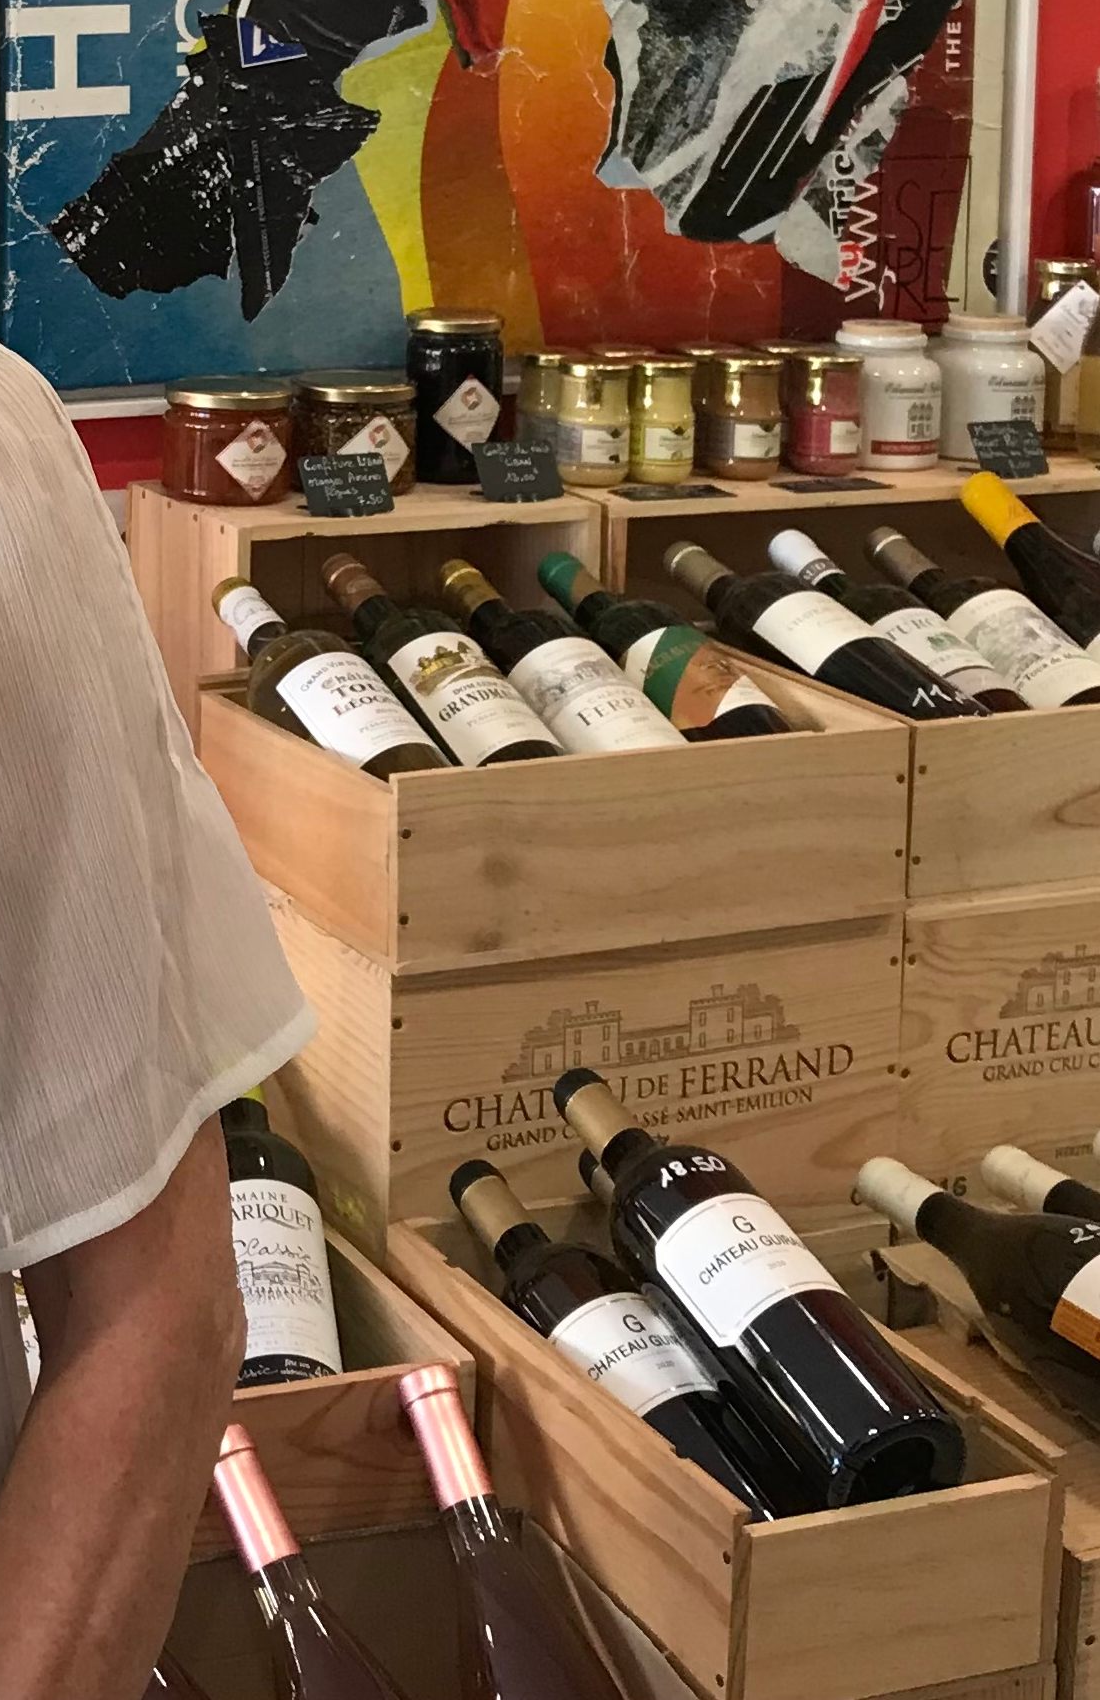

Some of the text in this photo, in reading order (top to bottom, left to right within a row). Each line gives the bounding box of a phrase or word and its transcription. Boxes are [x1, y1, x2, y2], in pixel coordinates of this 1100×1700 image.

[944, 21, 962, 72] THE
[636, 1073, 669, 1099] DE
[680, 1043, 854, 1099] FERRAND
[982, 1058, 1044, 1083] GRAND
[1049, 1054, 1084, 1074] CRU
[485, 1127, 557, 1153] GRAND
[677, 1086, 813, 1123] SAINT-EMILION
[660, 1155, 727, 1188] 18.50
[232, 1203, 314, 1232] ARIQUET
[732, 1215, 756, 1234] G
[698, 1237, 759, 1286] CHÂTEAU
[622, 1314, 646, 1334] G
[587, 1337, 648, 1382] CHÂTEAU
